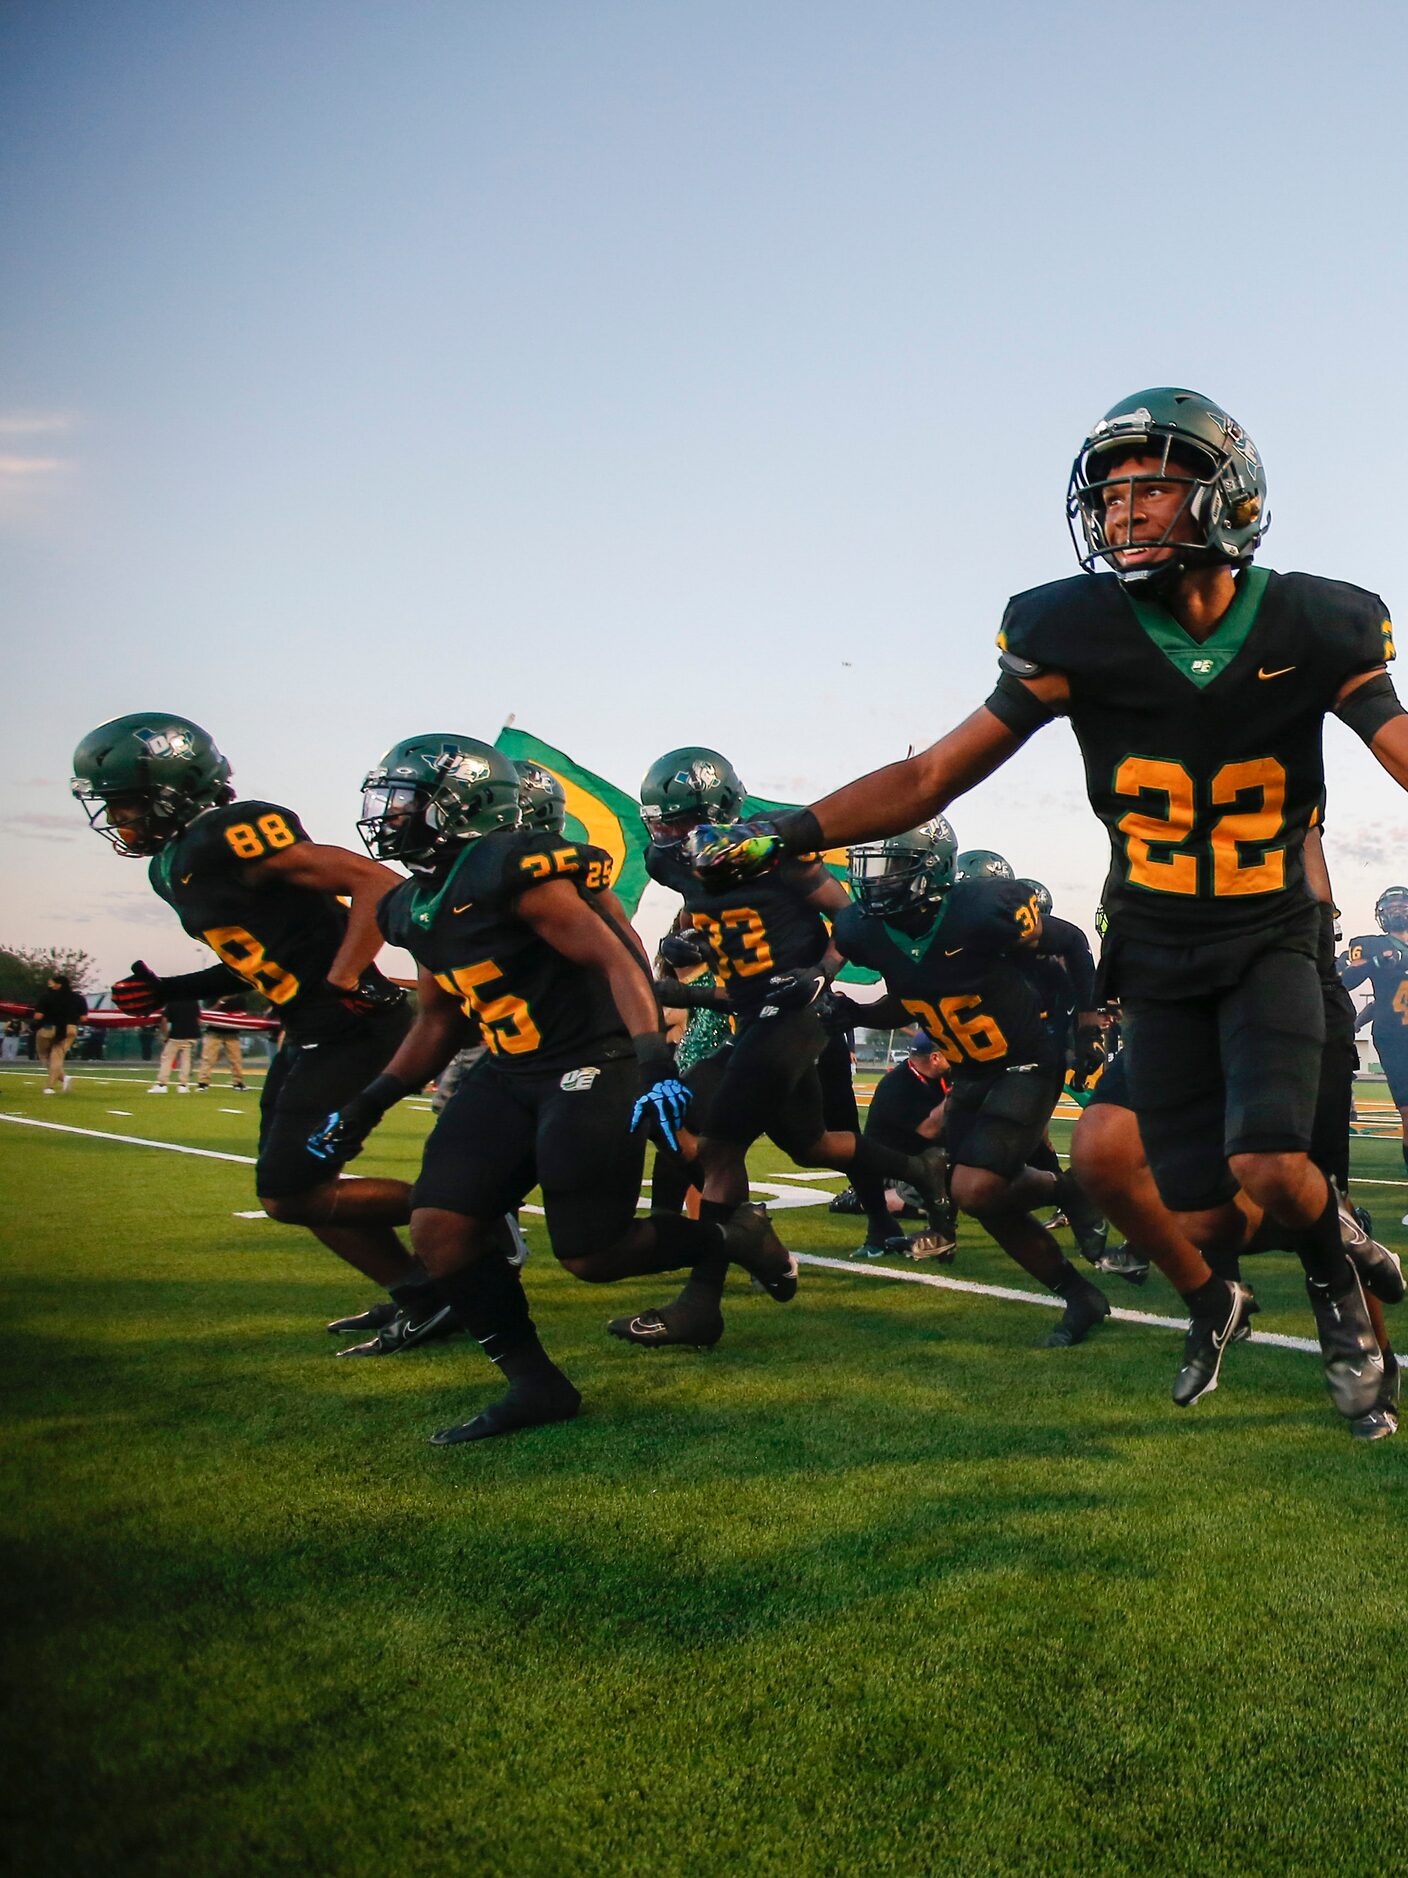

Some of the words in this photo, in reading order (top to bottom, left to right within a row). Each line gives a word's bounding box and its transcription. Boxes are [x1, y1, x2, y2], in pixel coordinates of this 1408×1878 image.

[223, 812, 296, 859] 88
[1112, 752, 1290, 898] 22
[900, 994, 1009, 1065] 36
